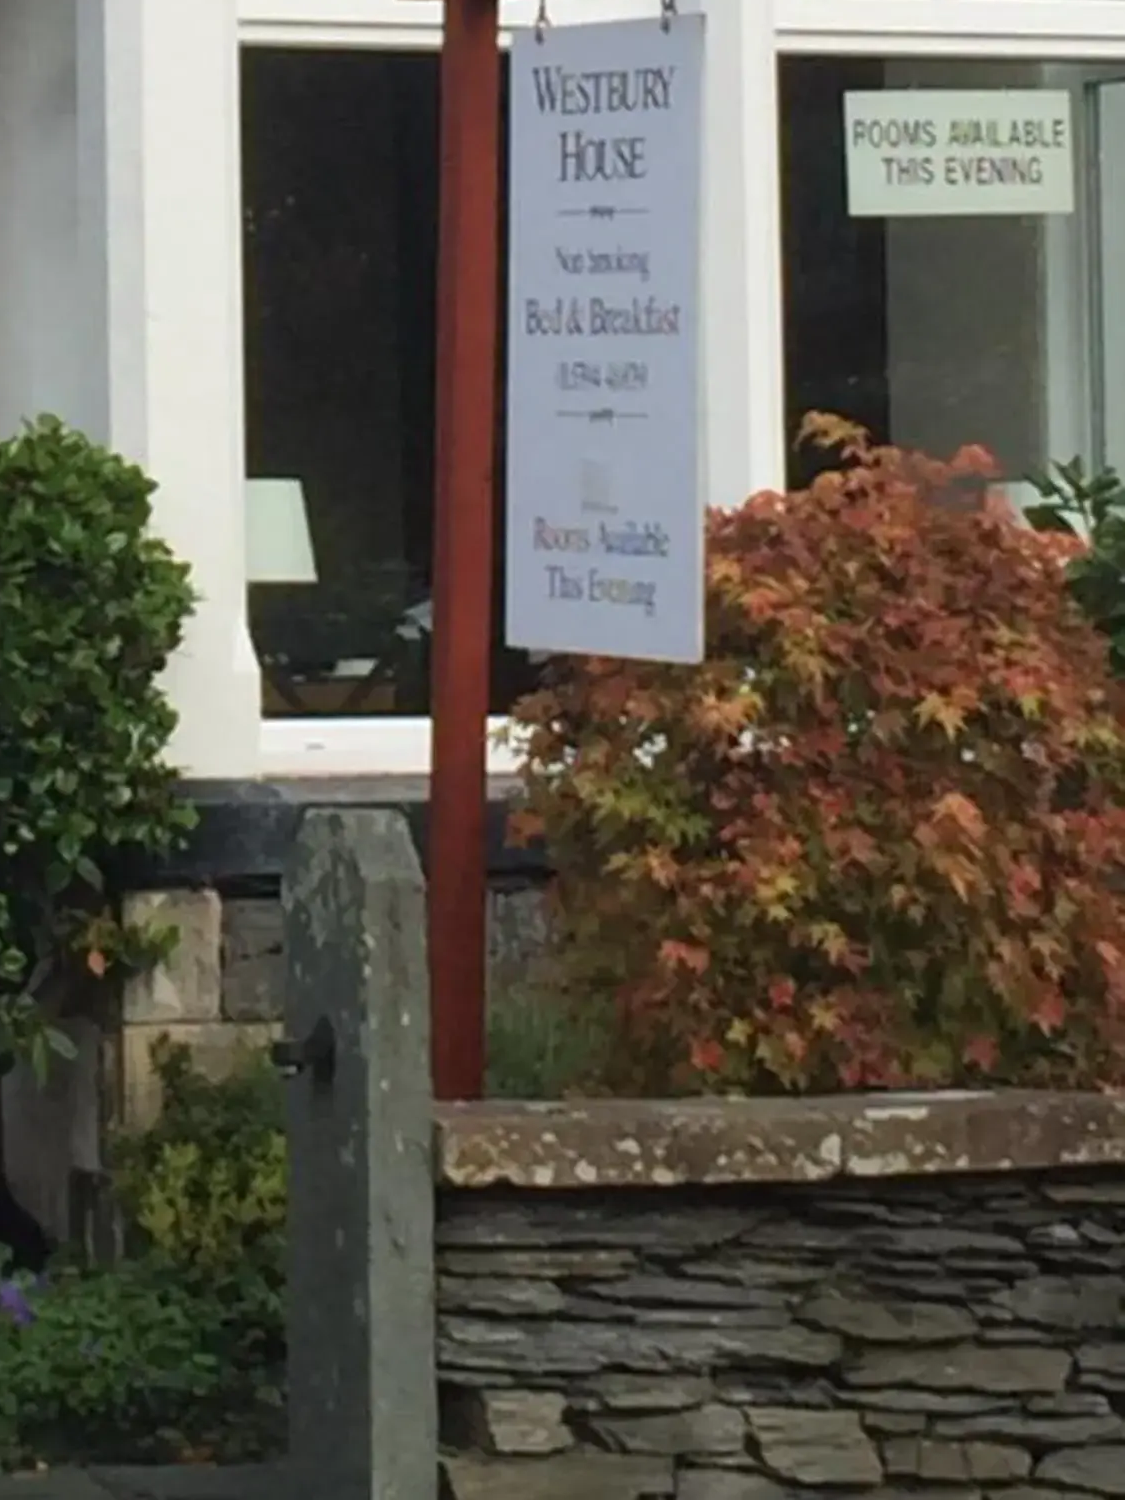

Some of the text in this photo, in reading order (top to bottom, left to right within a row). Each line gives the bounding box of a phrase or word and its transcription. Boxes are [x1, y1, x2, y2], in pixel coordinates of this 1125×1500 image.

[532, 65, 677, 115] WESTBURY
[852, 119, 1066, 148] ROOMS AVAILABLE
[558, 130, 646, 182] HOUSE
[881, 156, 1043, 186] THIS EVENING
[525, 295, 681, 335] Bed & Breakfast
[533, 516, 591, 552] Rooms
[544, 564, 657, 618] This Evening
